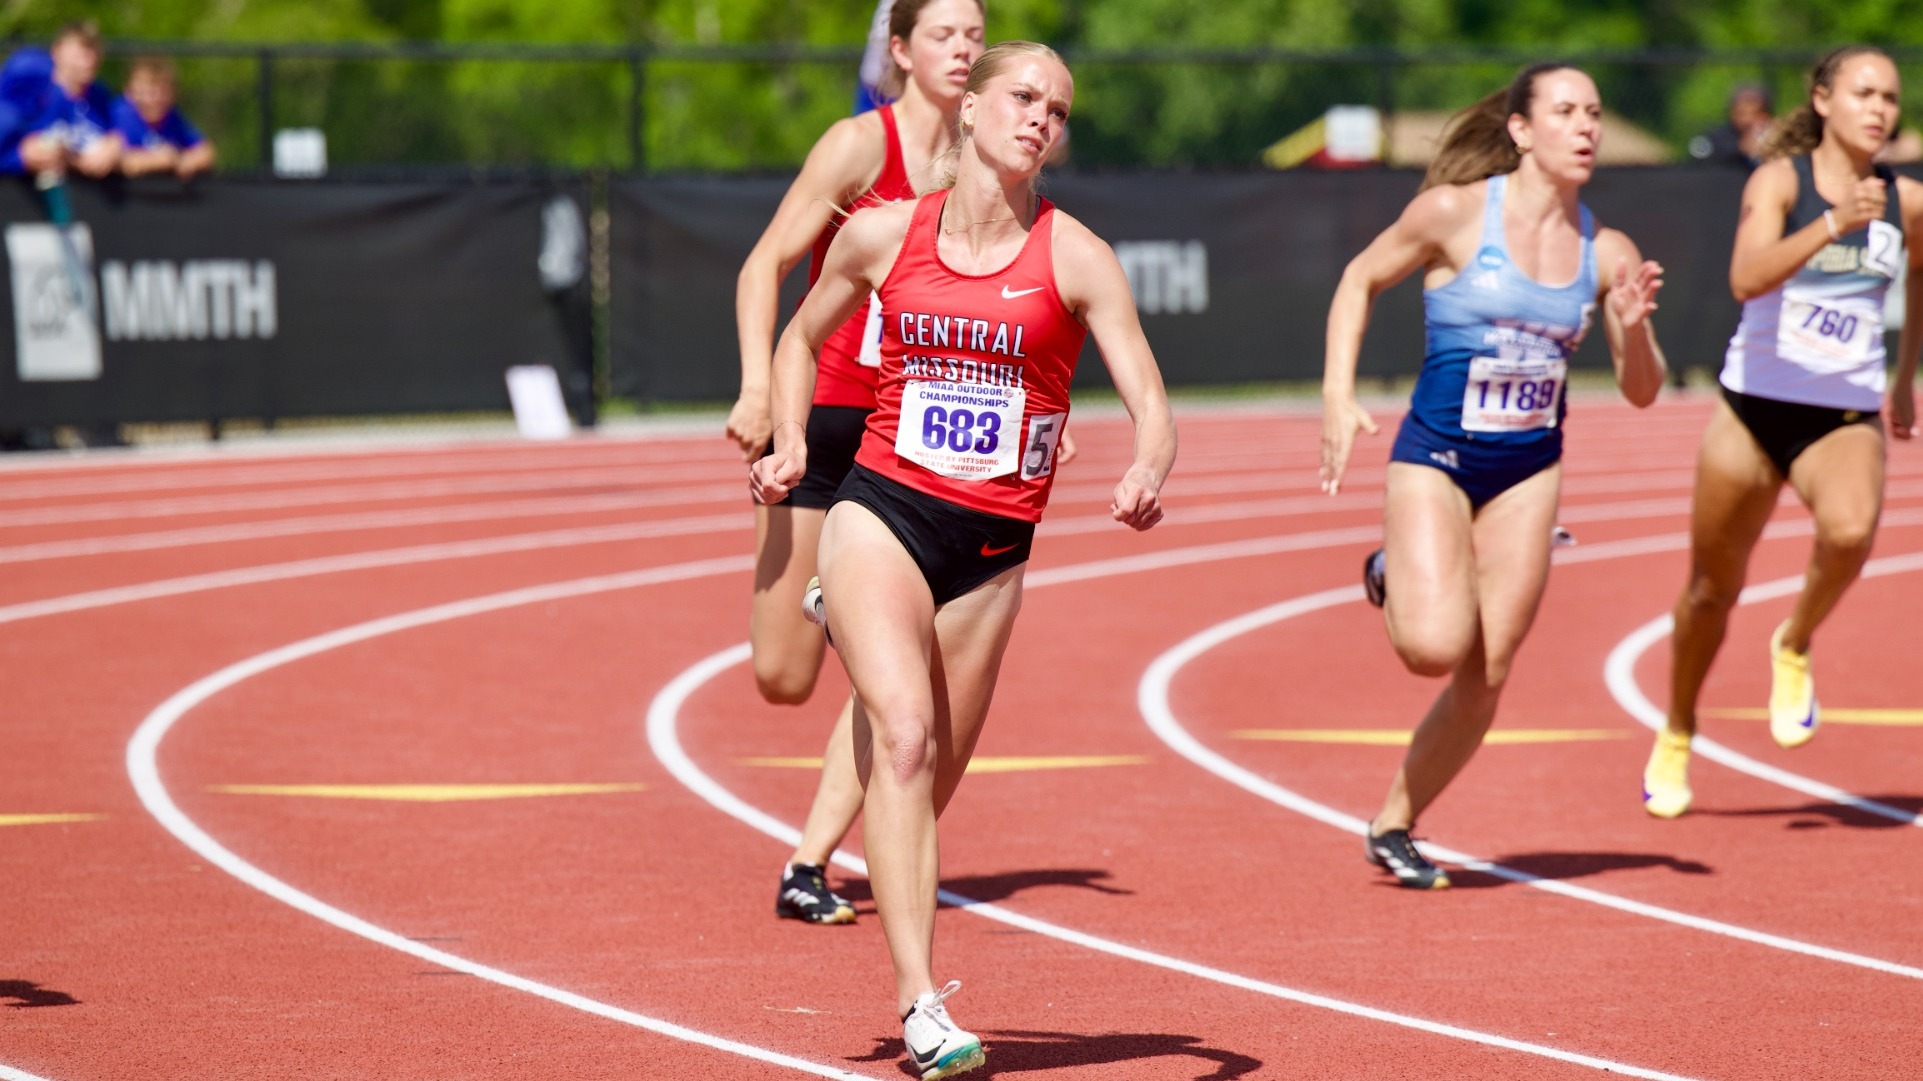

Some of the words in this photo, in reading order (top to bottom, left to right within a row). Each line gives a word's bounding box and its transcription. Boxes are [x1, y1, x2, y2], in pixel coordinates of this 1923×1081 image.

[1873, 230, 1891, 266] 2
[1111, 239, 1209, 315] TH
[102, 258, 278, 341] MMTH
[899, 311, 1027, 358] CENTRAL
[1802, 303, 1858, 344] 760
[901, 353, 1025, 389] MISSOURI
[928, 380, 954, 392] MIAA
[957, 384, 1003, 396] OUTDOOR
[919, 390, 1010, 408] CHAMPIONSHIPS
[1476, 379, 1556, 411] 1189
[922, 406, 1001, 455] 683
[919, 459, 945, 469] STATE
[947, 463, 992, 473] UNIVERSITY
[945, 455, 956, 463] BY
[958, 456, 999, 466] PITTSBURG
[1026, 422, 1054, 476] 5
